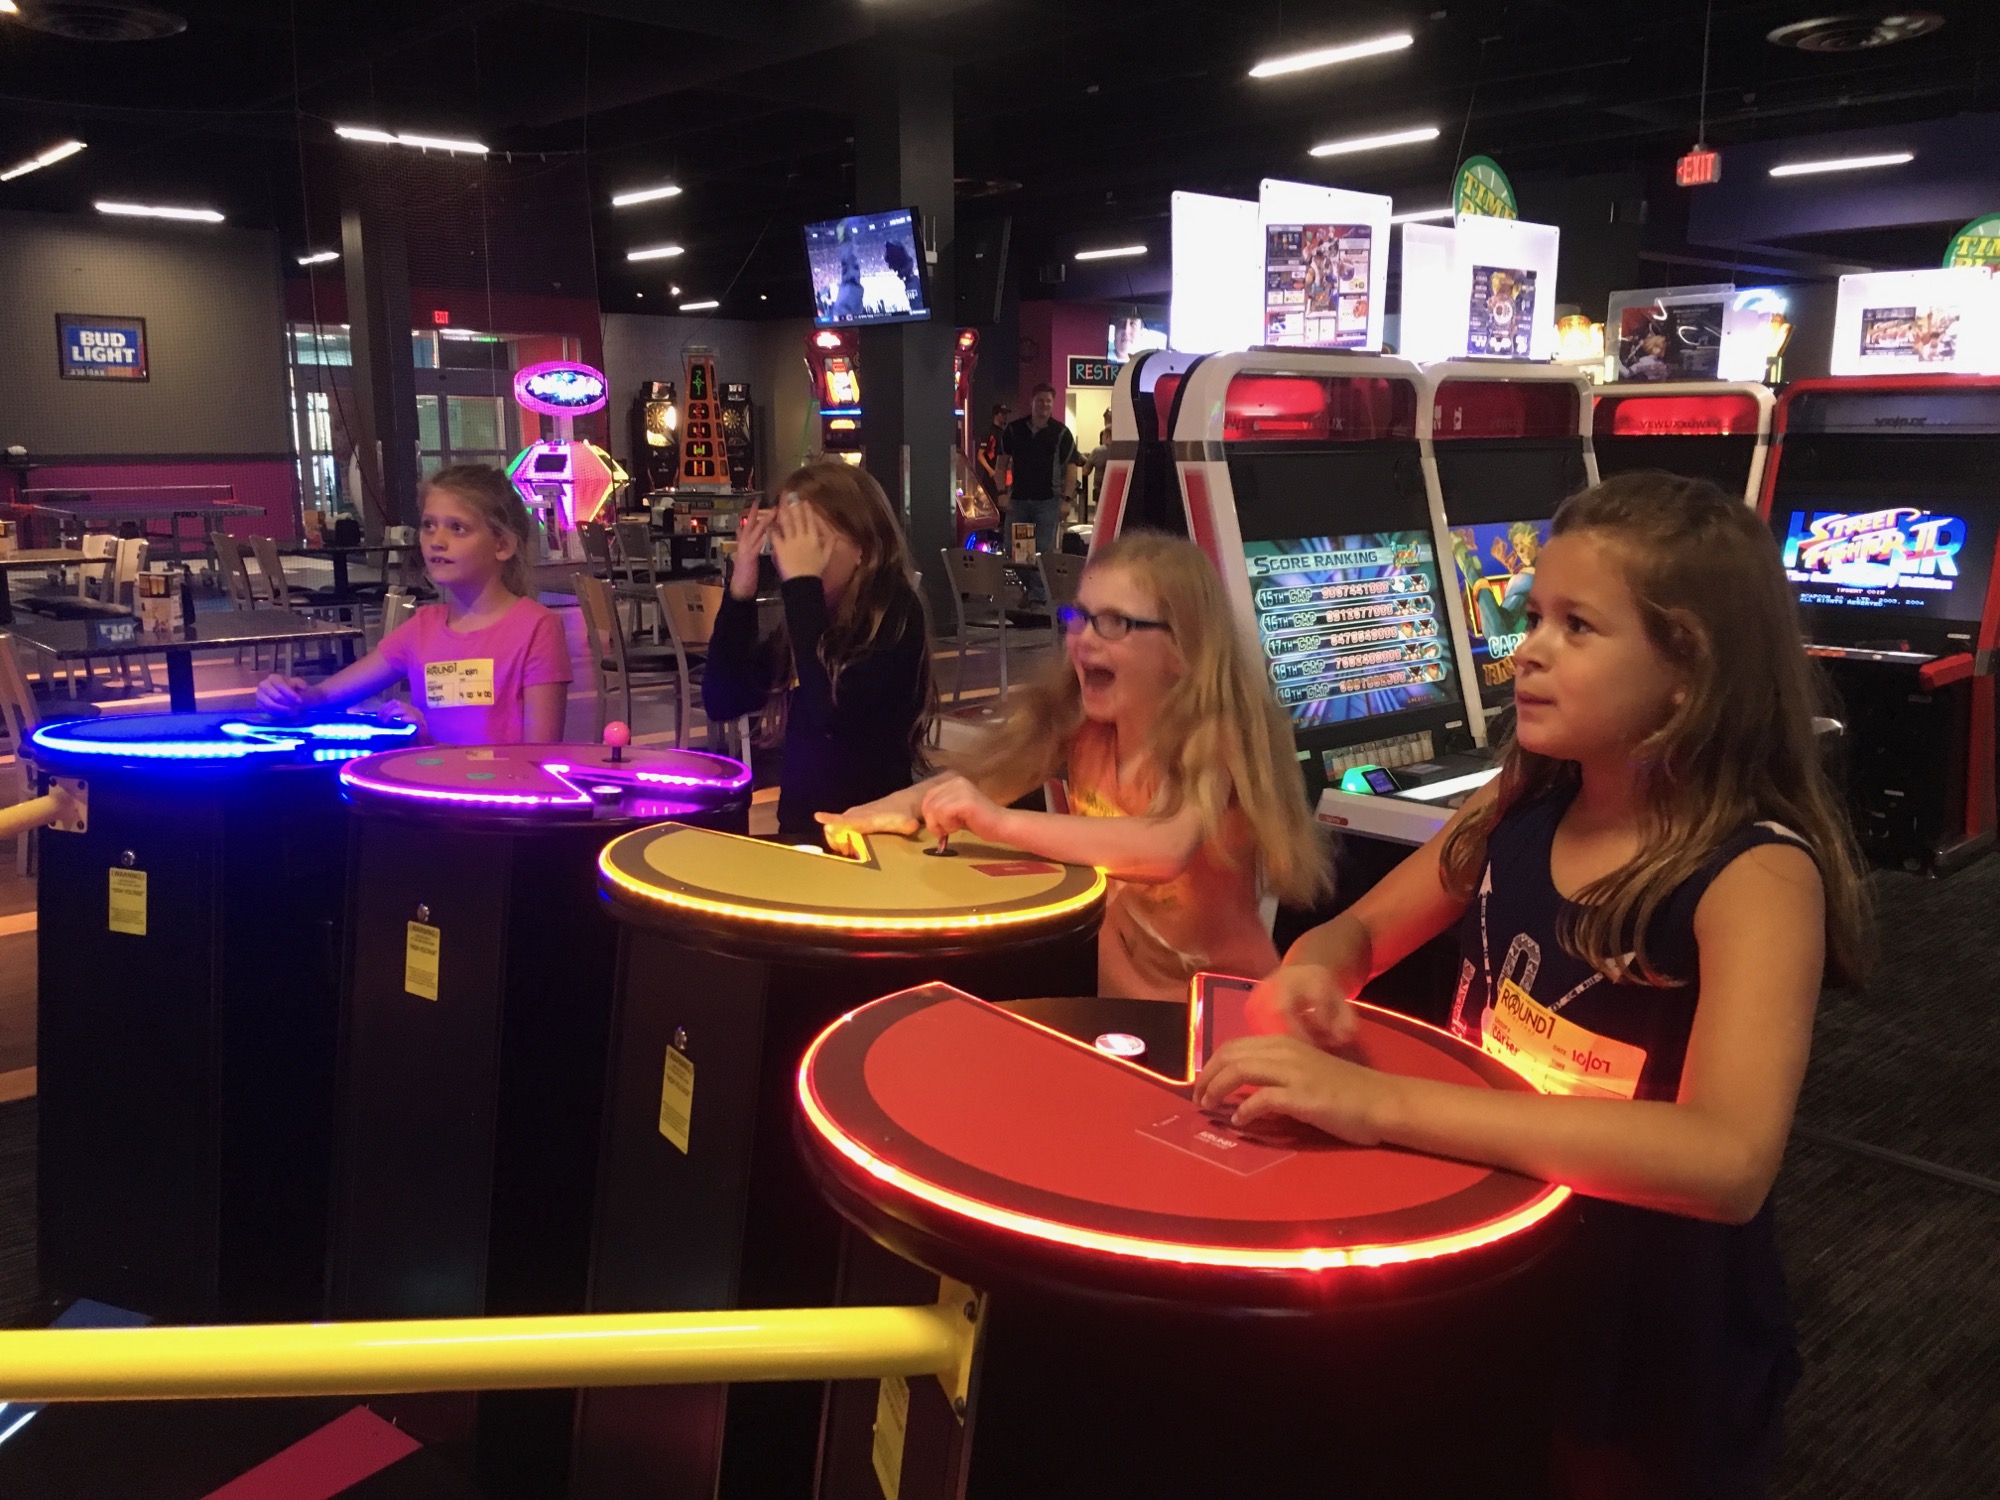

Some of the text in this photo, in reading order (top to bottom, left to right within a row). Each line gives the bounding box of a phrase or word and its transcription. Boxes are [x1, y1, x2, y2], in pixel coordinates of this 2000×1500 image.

[1683, 153, 1715, 184] EXIT
[434, 310, 449, 324] EXIT
[79, 330, 126, 347] BUD
[71, 345, 136, 363] LIGHT
[1806, 507, 1921, 546] STREET
[1254, 555, 1311, 575] SCORE
[1314, 551, 1378, 567] RANKING
[1260, 590, 1285, 607] 15TH
[1265, 615, 1289, 631] 16TH
[1269, 639, 1293, 655] 17TH
[1488, 632, 1526, 659] CAP
[1274, 663, 1298, 680] 18TH
[1278, 687, 1302, 703] 19TH
[1501, 987, 1557, 1039] ROUND1
[1571, 1048, 1611, 1074] 10/07
